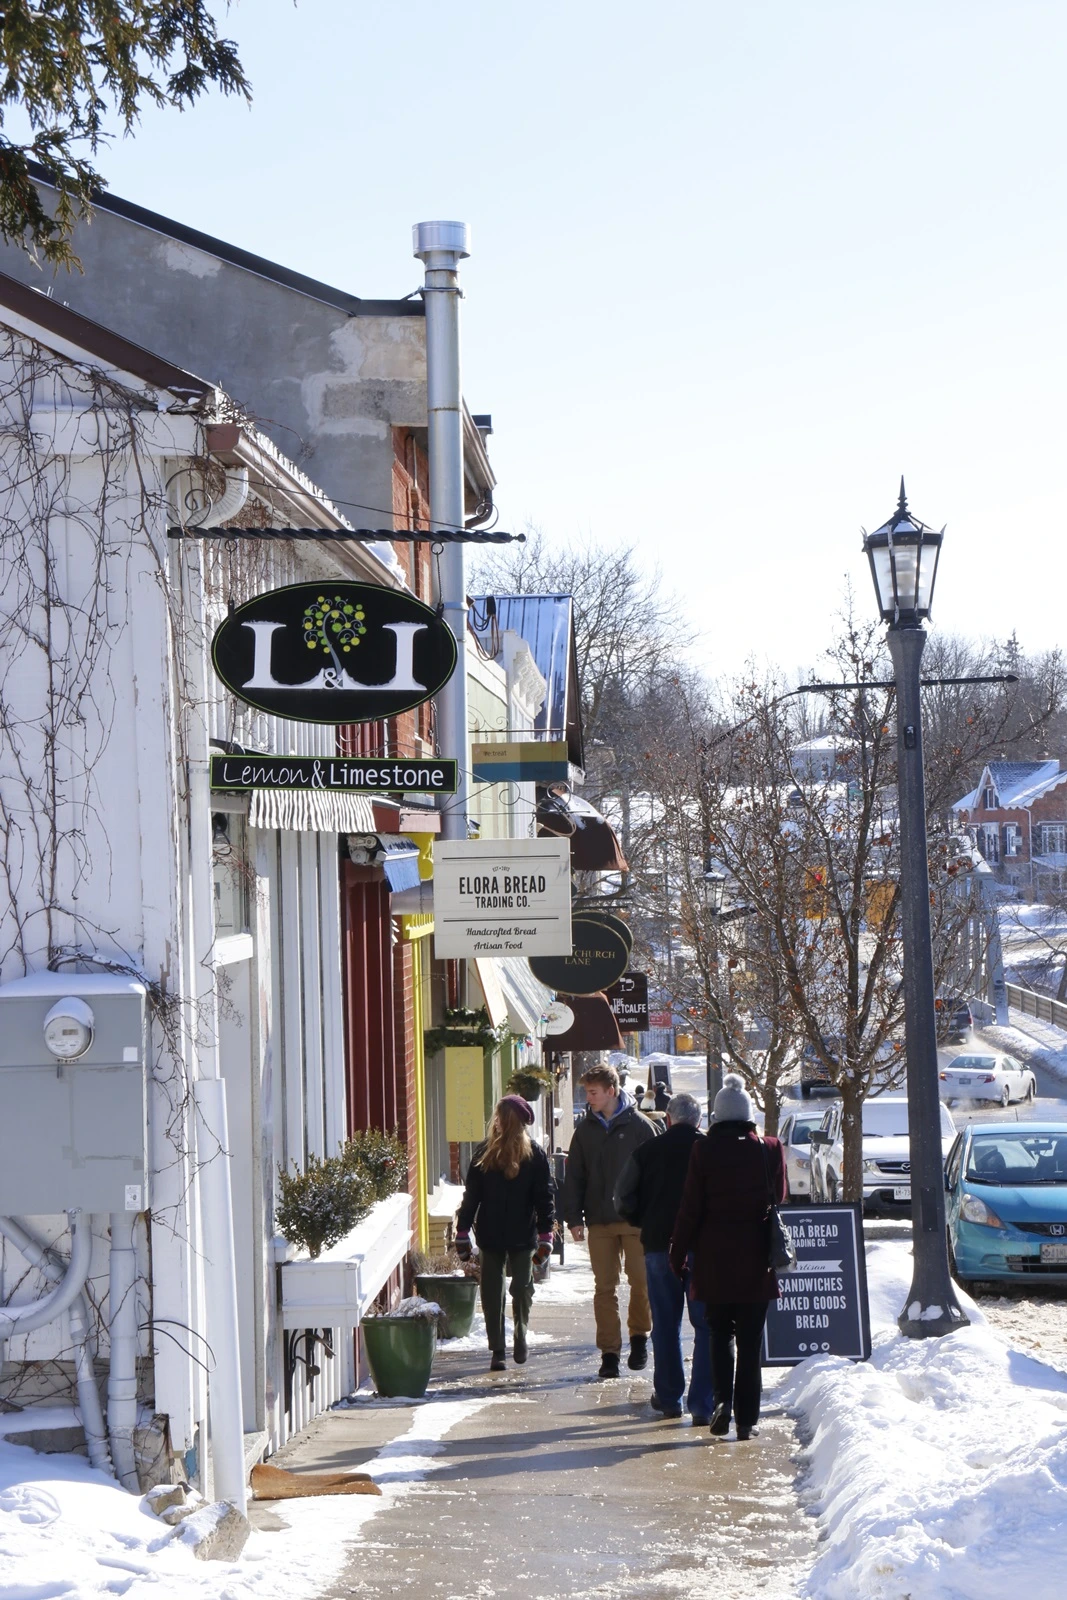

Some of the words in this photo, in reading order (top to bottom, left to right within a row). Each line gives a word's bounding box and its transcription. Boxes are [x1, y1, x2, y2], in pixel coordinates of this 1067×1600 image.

[459, 876, 499, 894] ELORA
[504, 875, 546, 893] BREAD
[475, 896, 514, 908] TRADING
[516, 895, 531, 907] CO.
[465, 927, 512, 938] Handcrafted
[514, 927, 537, 935] Bread
[473, 941, 503, 950] Artisan
[504, 941, 523, 949] Food
[573, 949, 615, 958] CHURCH
[564, 957, 591, 965] LANE
[609, 1004, 646, 1013] METCALFE
[786, 1225, 805, 1238] ORA
[808, 1224, 838, 1237] BREAD
[792, 1238, 816, 1247] RADING
[817, 1239, 828, 1247] CO.
[778, 1277, 843, 1292] SANDWICHES
[777, 1297, 809, 1311] BAKED
[813, 1296, 847, 1310] GOODS
[796, 1314, 829, 1329] BREAD
